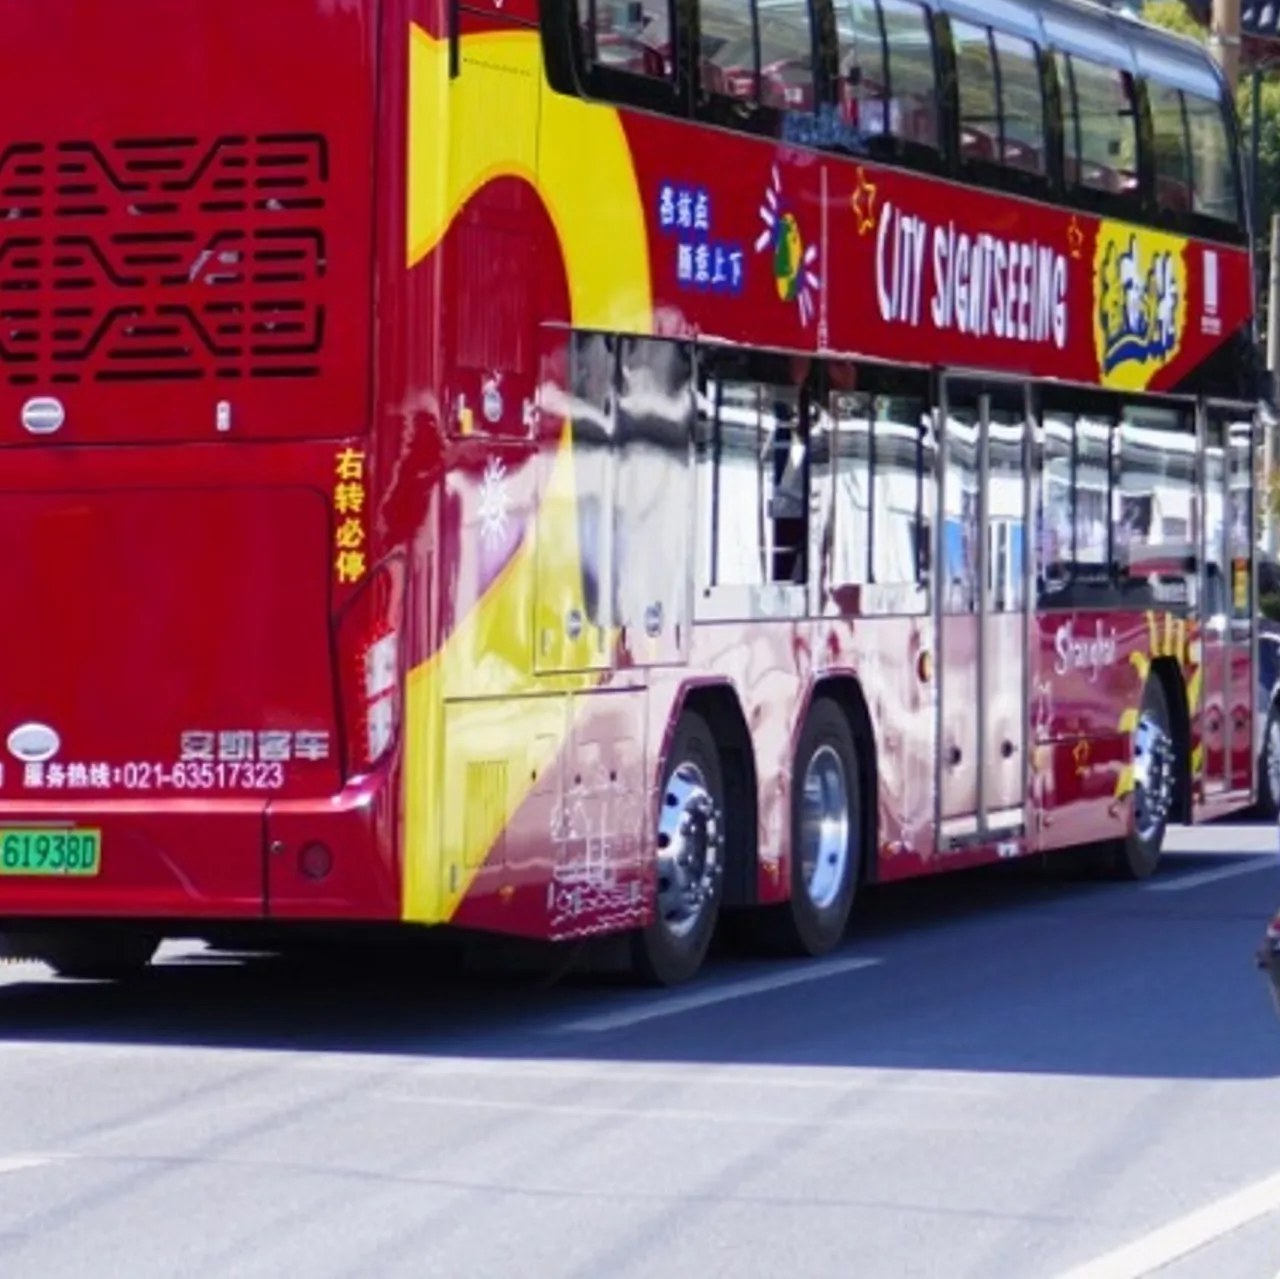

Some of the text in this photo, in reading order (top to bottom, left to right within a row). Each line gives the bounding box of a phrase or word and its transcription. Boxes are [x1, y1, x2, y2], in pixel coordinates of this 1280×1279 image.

[876, 202, 926, 327] CITY
[931, 220, 1067, 349] SIGHTSEEING
[334, 448, 366, 583] 右转必停
[1054, 619, 1116, 684] Shanghai
[180, 730, 330, 761] 安凯客车
